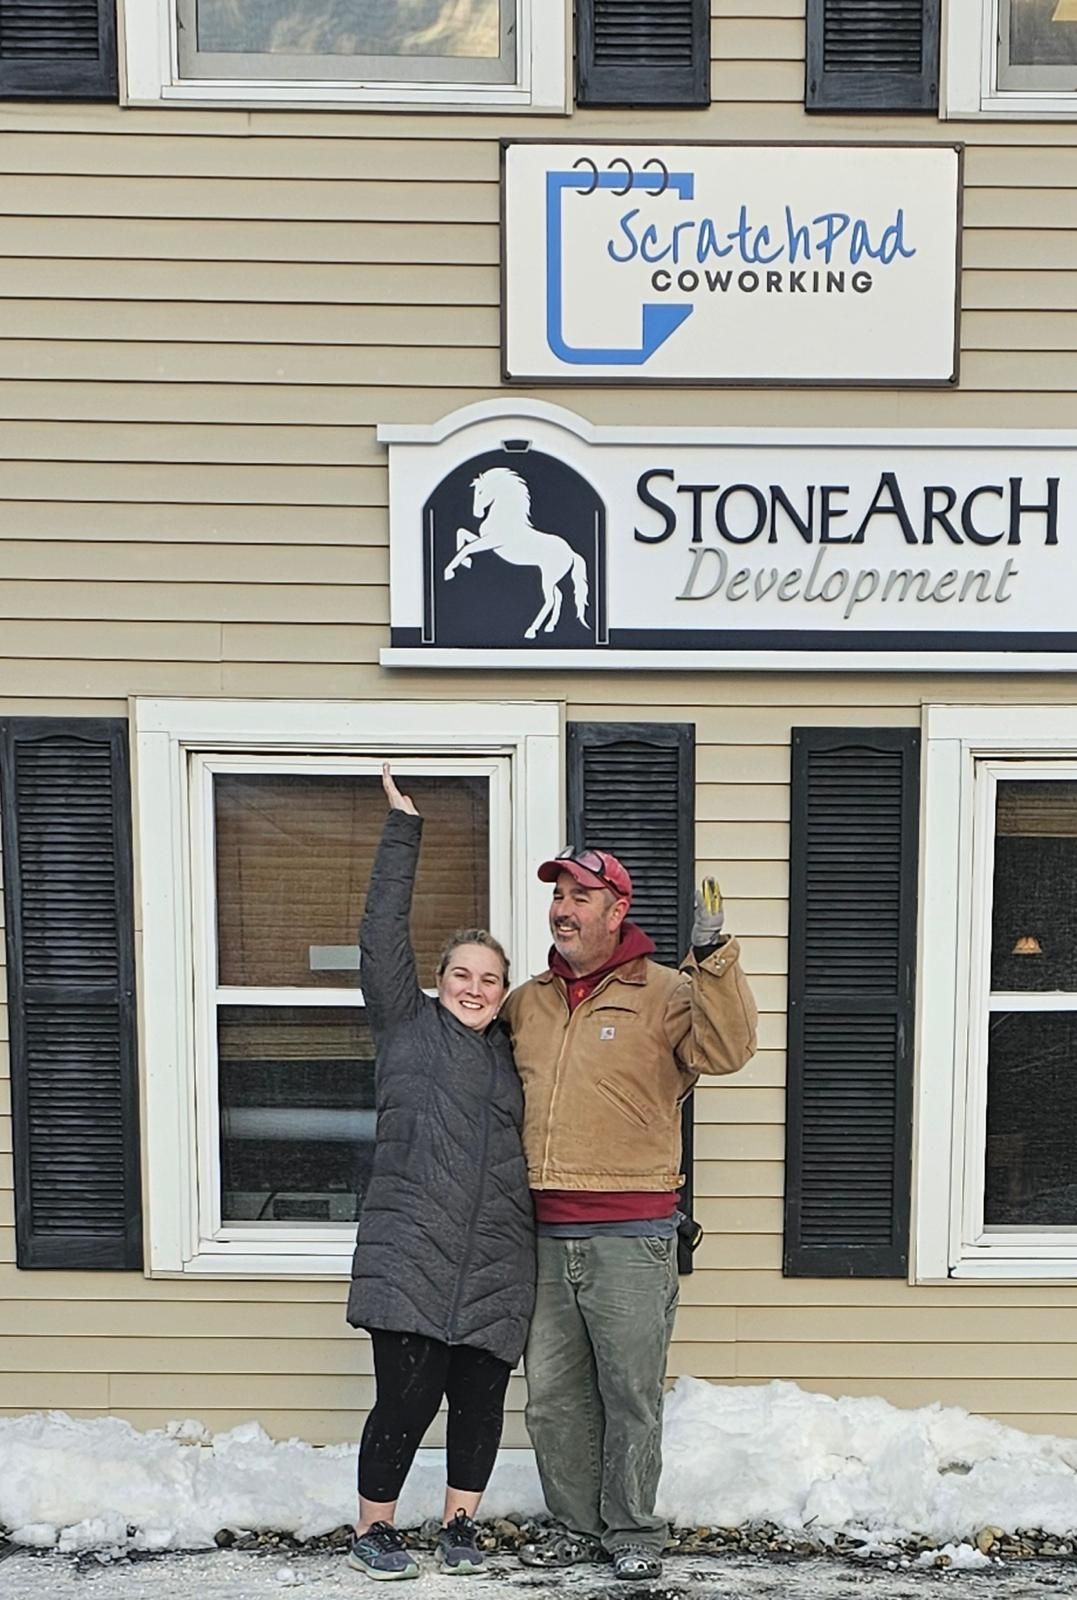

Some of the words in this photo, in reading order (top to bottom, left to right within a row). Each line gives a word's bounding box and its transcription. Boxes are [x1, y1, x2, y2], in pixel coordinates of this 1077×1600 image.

[607, 205, 917, 265] ScratchPad
[651, 269, 873, 293] COWORKING
[675, 546, 1018, 620] Development
